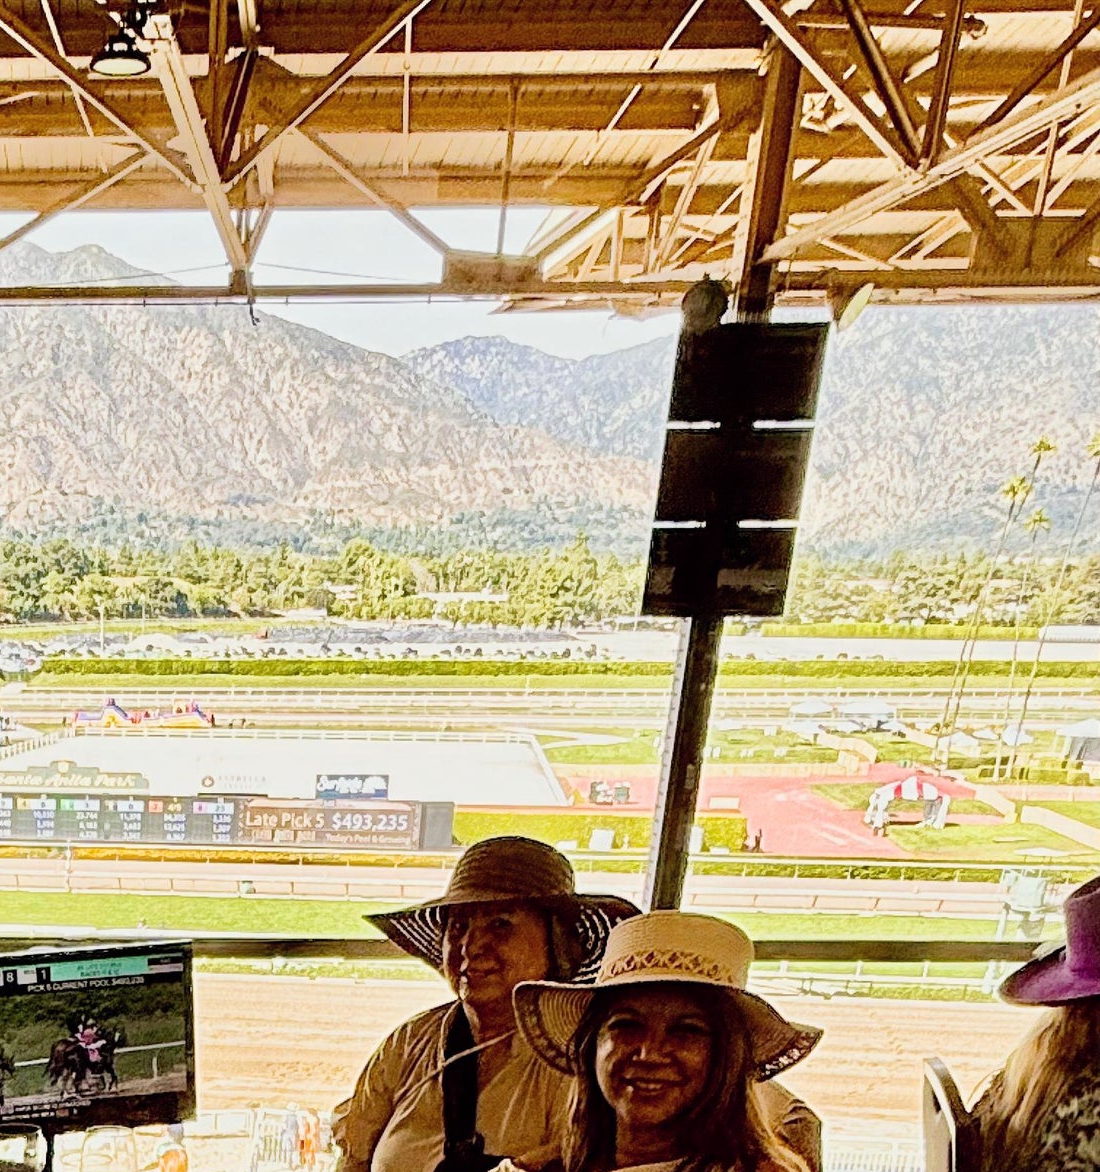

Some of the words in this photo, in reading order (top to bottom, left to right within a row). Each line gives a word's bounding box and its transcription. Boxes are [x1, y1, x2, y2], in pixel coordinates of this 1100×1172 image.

[45, 771, 91, 787] Anita
[94, 775, 136, 788] Park
[246, 810, 278, 827] Late
[281, 812, 312, 828] Pick
[316, 814, 325, 829] 5
[332, 812, 408, 831] $493,235
[6, 971, 14, 983] 8
[40, 969, 47, 981] 1
[53, 981, 87, 991] CURRENT
